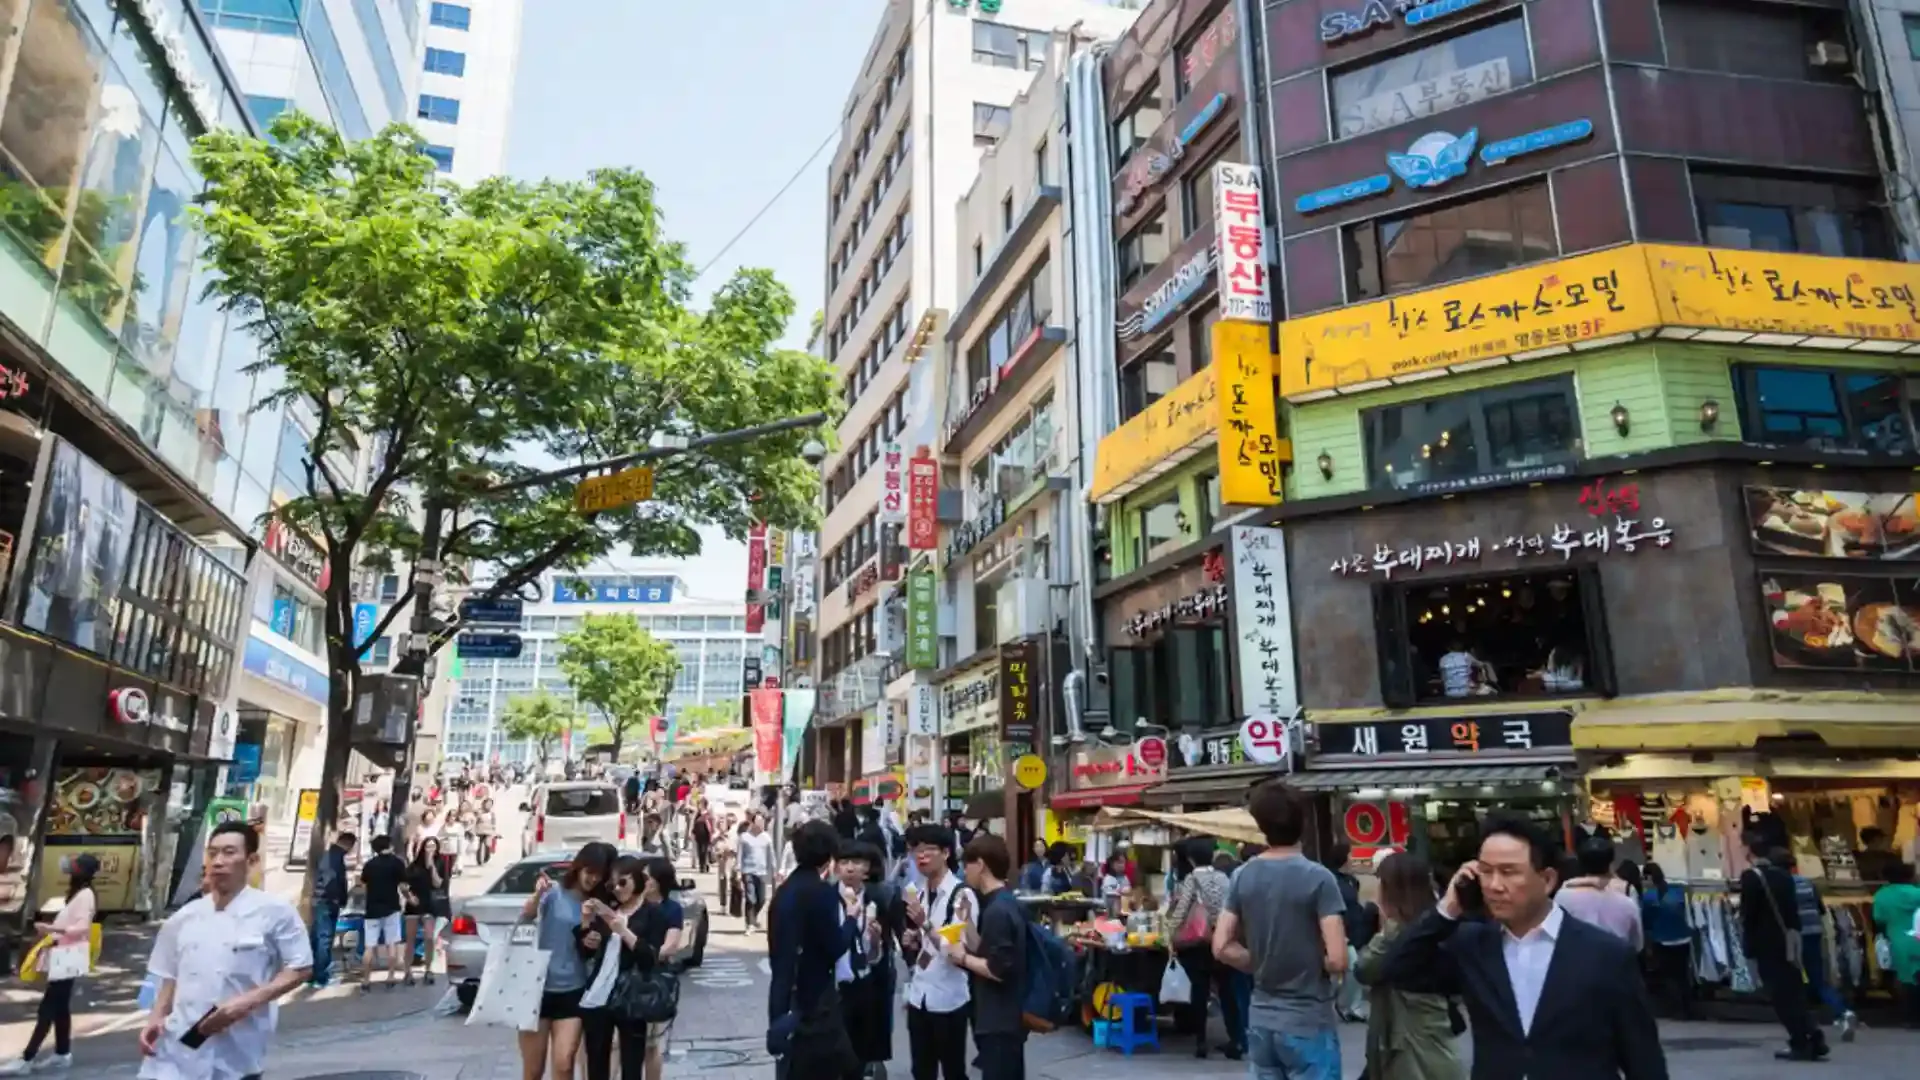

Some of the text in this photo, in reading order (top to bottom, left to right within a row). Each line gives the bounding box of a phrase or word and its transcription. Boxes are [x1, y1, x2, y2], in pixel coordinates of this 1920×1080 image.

[1222, 167, 1261, 189] S&A
[1226, 190, 1264, 296] 부동산
[1259, 434, 1282, 496] 모밀
[1247, 719, 1284, 756] 약
